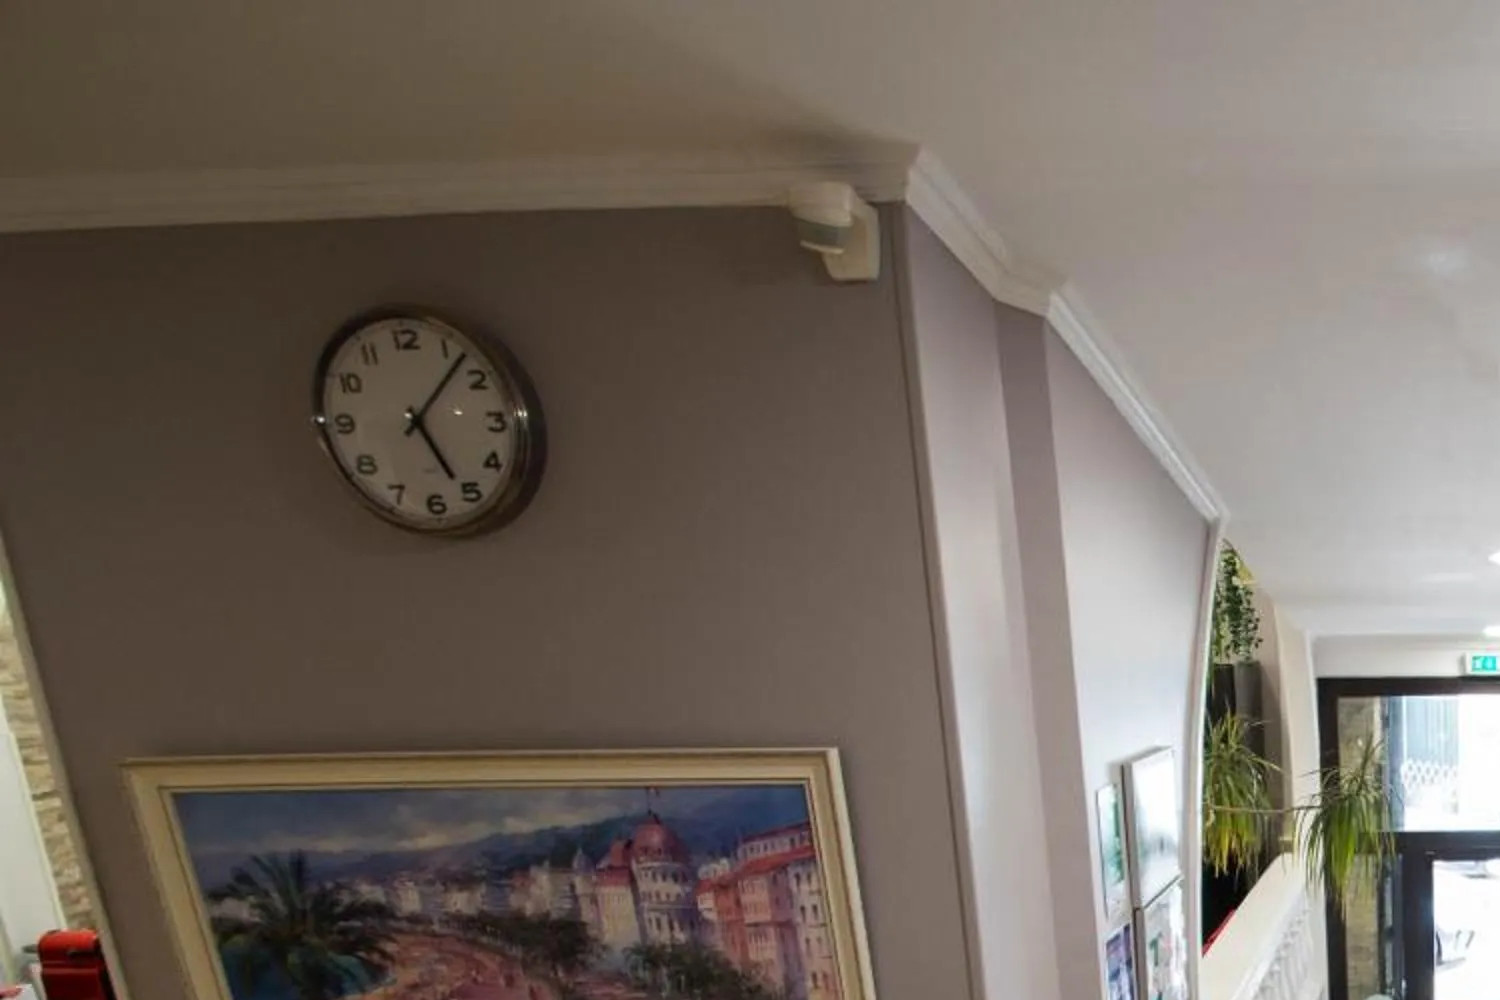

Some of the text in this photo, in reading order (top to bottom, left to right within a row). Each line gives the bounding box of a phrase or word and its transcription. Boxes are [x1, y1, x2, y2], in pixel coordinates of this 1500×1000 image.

[393, 329, 421, 350] 12
[440, 339, 449, 359] 1
[362, 343, 378, 365] 11
[340, 373, 362, 393] 10
[467, 370, 489, 390] 2
[335, 414, 356, 434] 9
[486, 411, 507, 432] 3
[356, 455, 378, 475] 8
[483, 452, 502, 472] 4
[388, 484, 405, 504] 7
[461, 482, 483, 502] 5
[426, 495, 447, 515] 6
